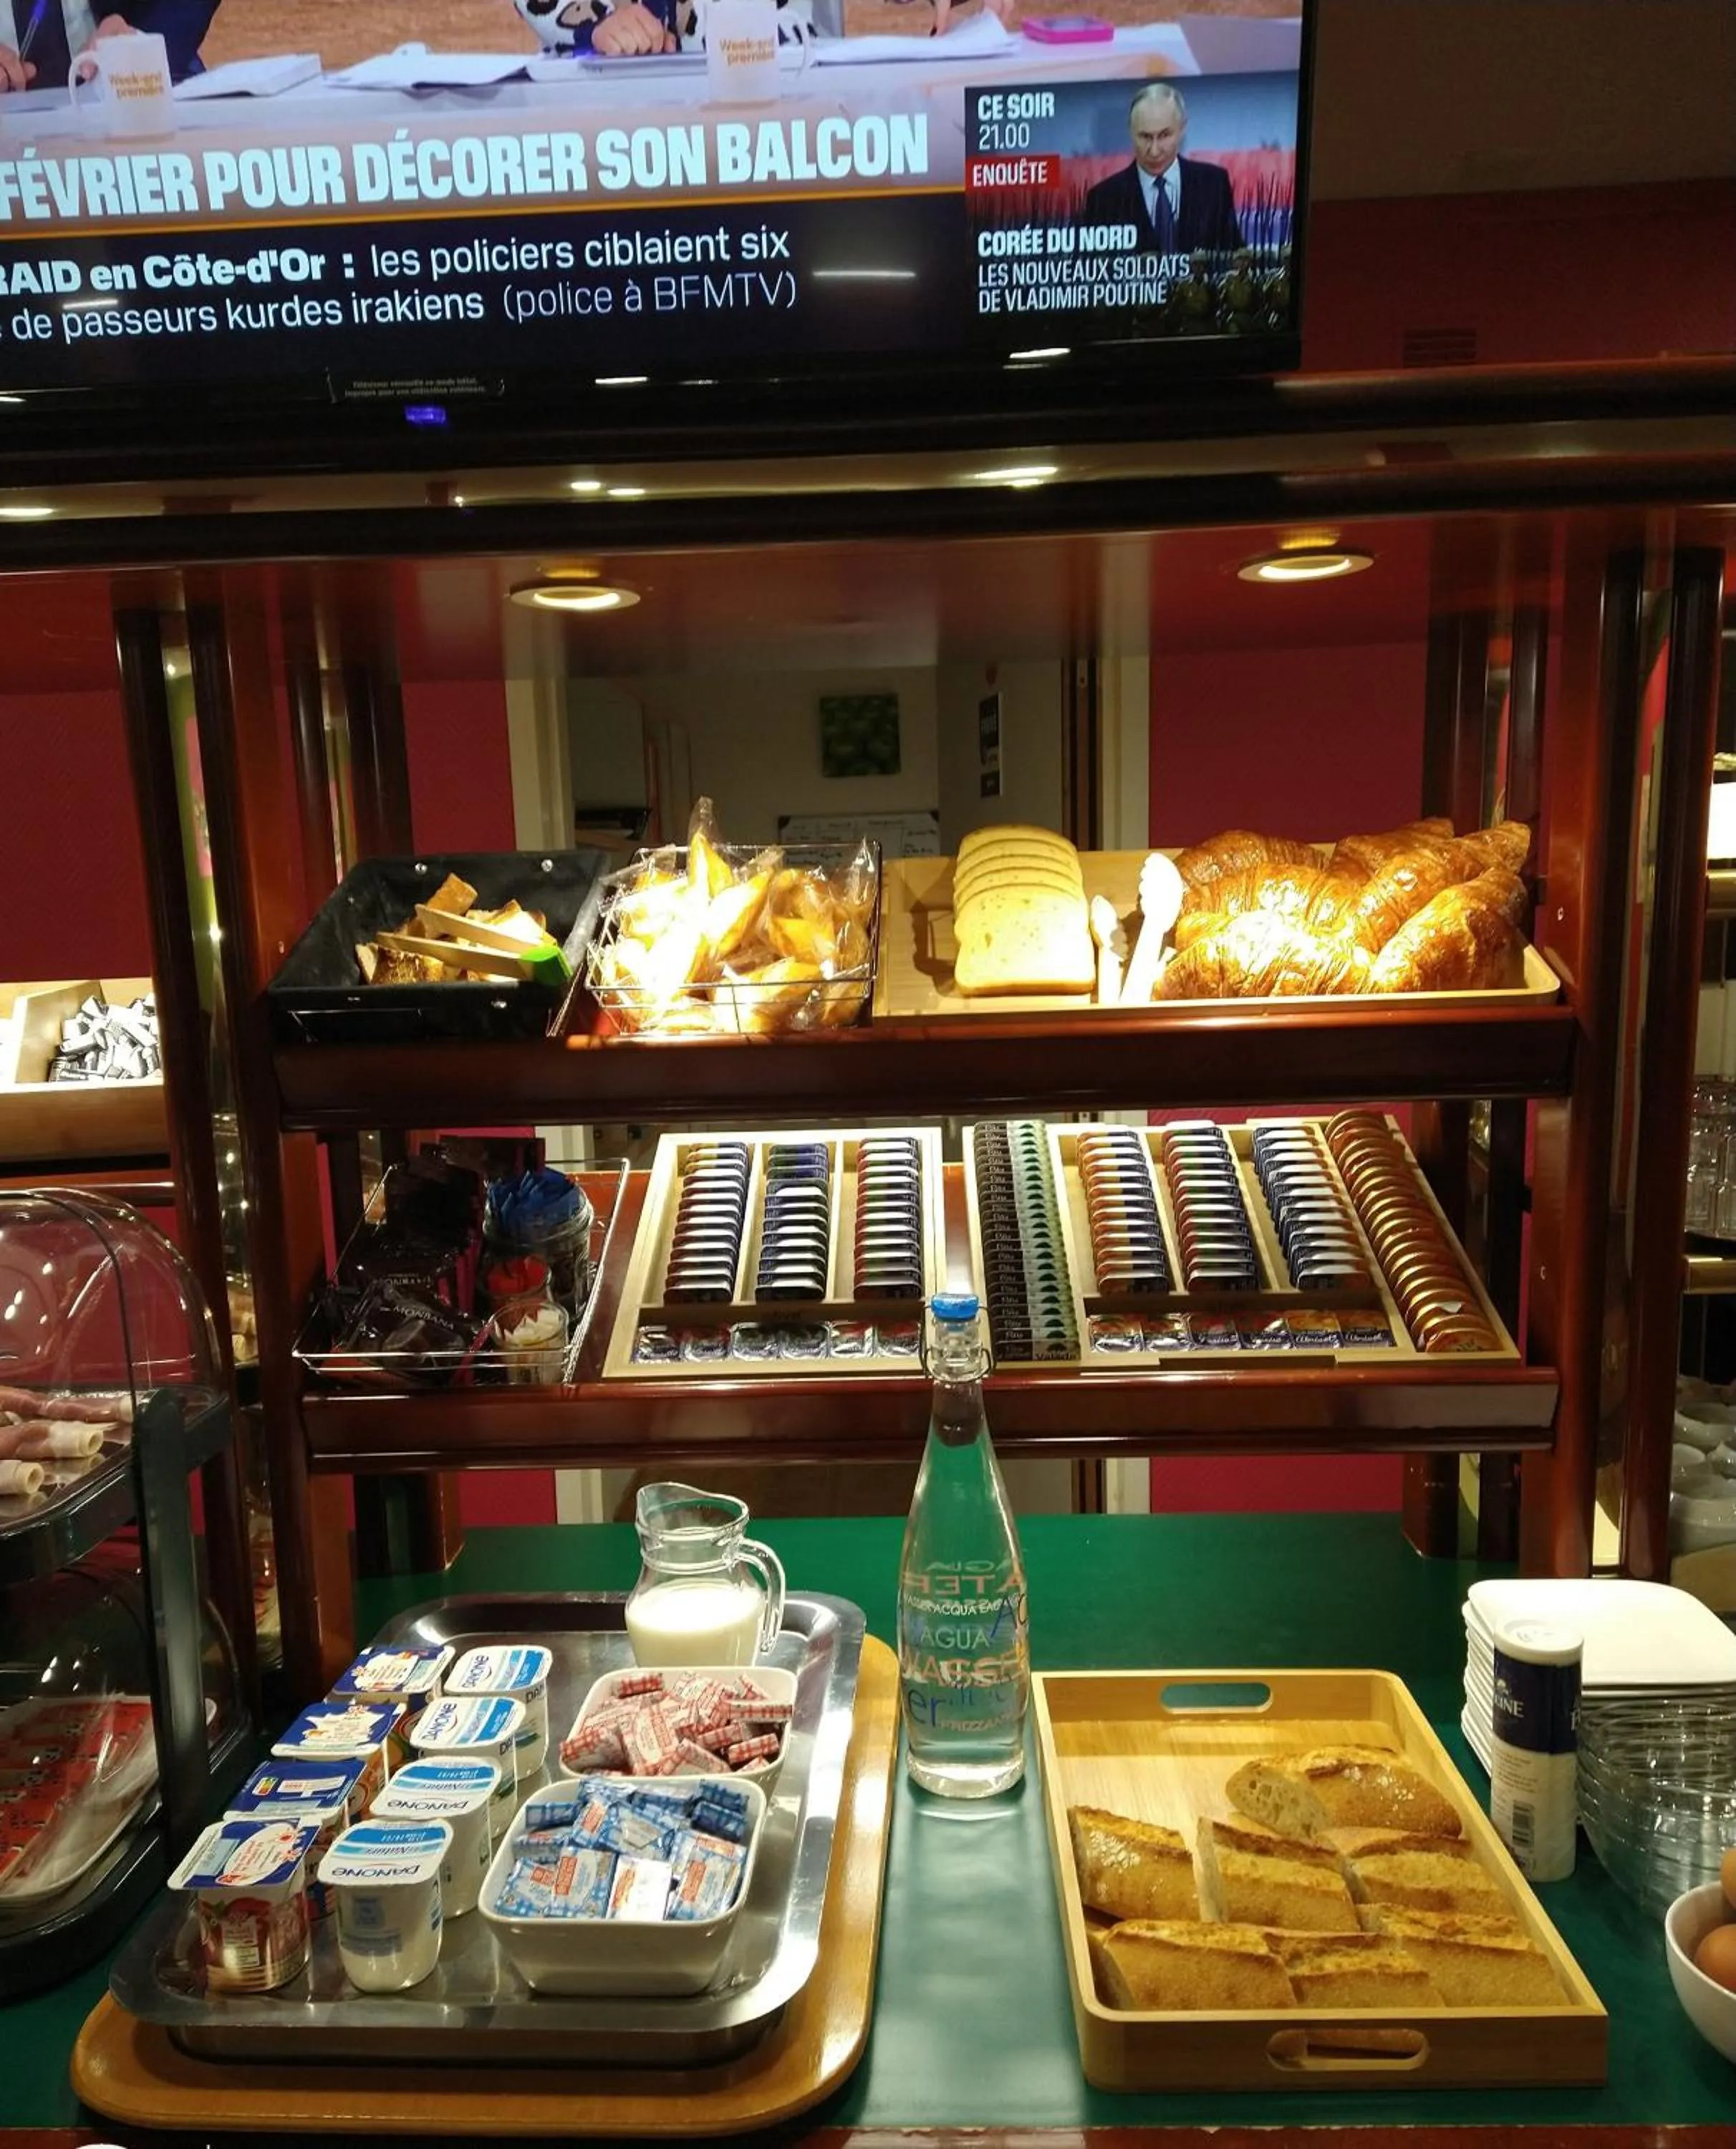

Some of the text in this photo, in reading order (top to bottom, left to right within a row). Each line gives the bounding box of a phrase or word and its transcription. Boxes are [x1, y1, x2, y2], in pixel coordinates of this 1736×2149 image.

[978, 92, 1055, 121] CE SOIR
[978, 122, 1030, 150] 21.00
[0, 113, 929, 220] FÉVRIER POUR DÉCORER SON BALCON
[973, 159, 1047, 187] ENQUÊTE
[978, 223, 1137, 258] CORÉE DU NORD
[90, 264, 137, 292] en
[143, 248, 325, 288] Côte-d'Or
[371, 244, 421, 277] les
[430, 238, 574, 287] policiers
[584, 226, 730, 267] ciblaient
[741, 224, 790, 260] six
[978, 253, 1190, 287] LES NOUVEAUX SOLDATS
[11, 271, 797, 345] de passeurs kurdes irakiens (police à BFMTV)
[979, 279, 1167, 314] DE VLADIMIR POUTINE
[920, 1626, 990, 1650] AGUA
[387, 1798, 470, 1812] DANONE
[332, 1864, 421, 1877] DANONE
